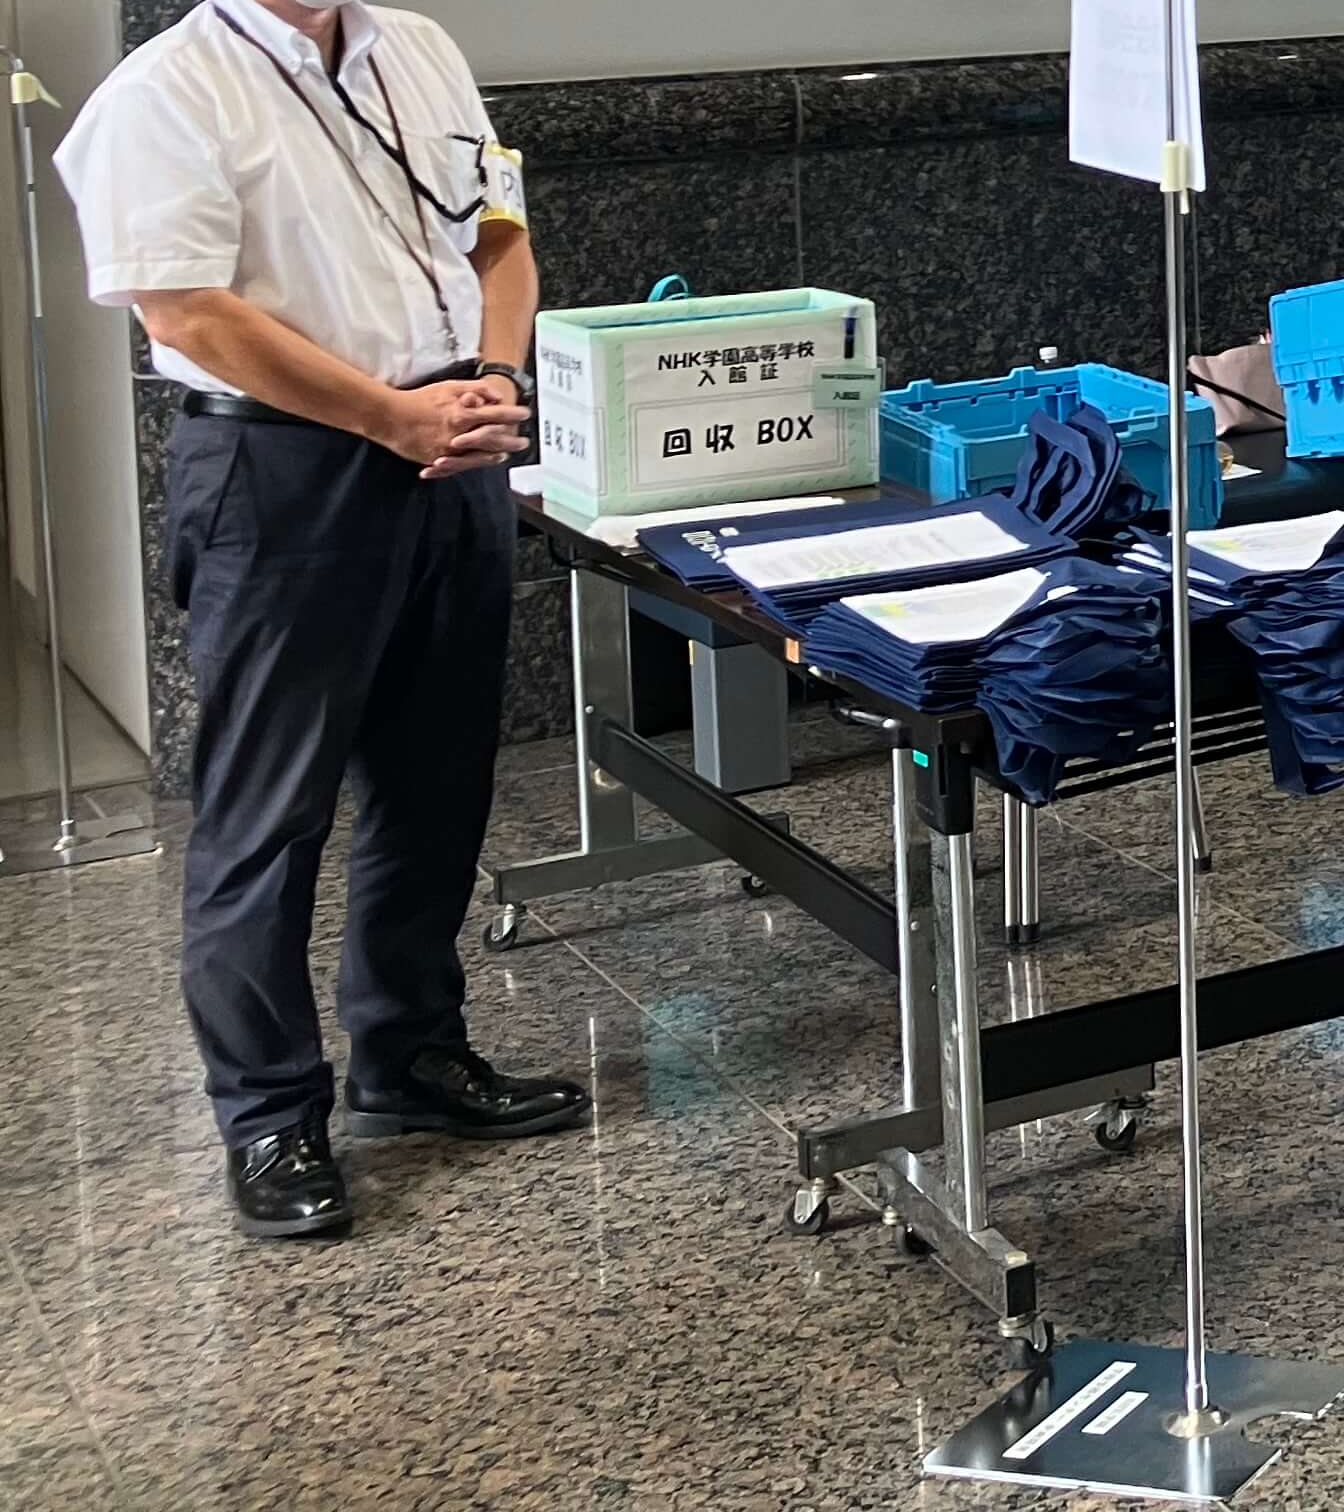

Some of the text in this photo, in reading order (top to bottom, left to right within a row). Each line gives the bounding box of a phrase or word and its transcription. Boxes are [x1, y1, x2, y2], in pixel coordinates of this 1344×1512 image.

[658, 341, 815, 370] NHK学園高等学校
[757, 414, 814, 445] BOX
